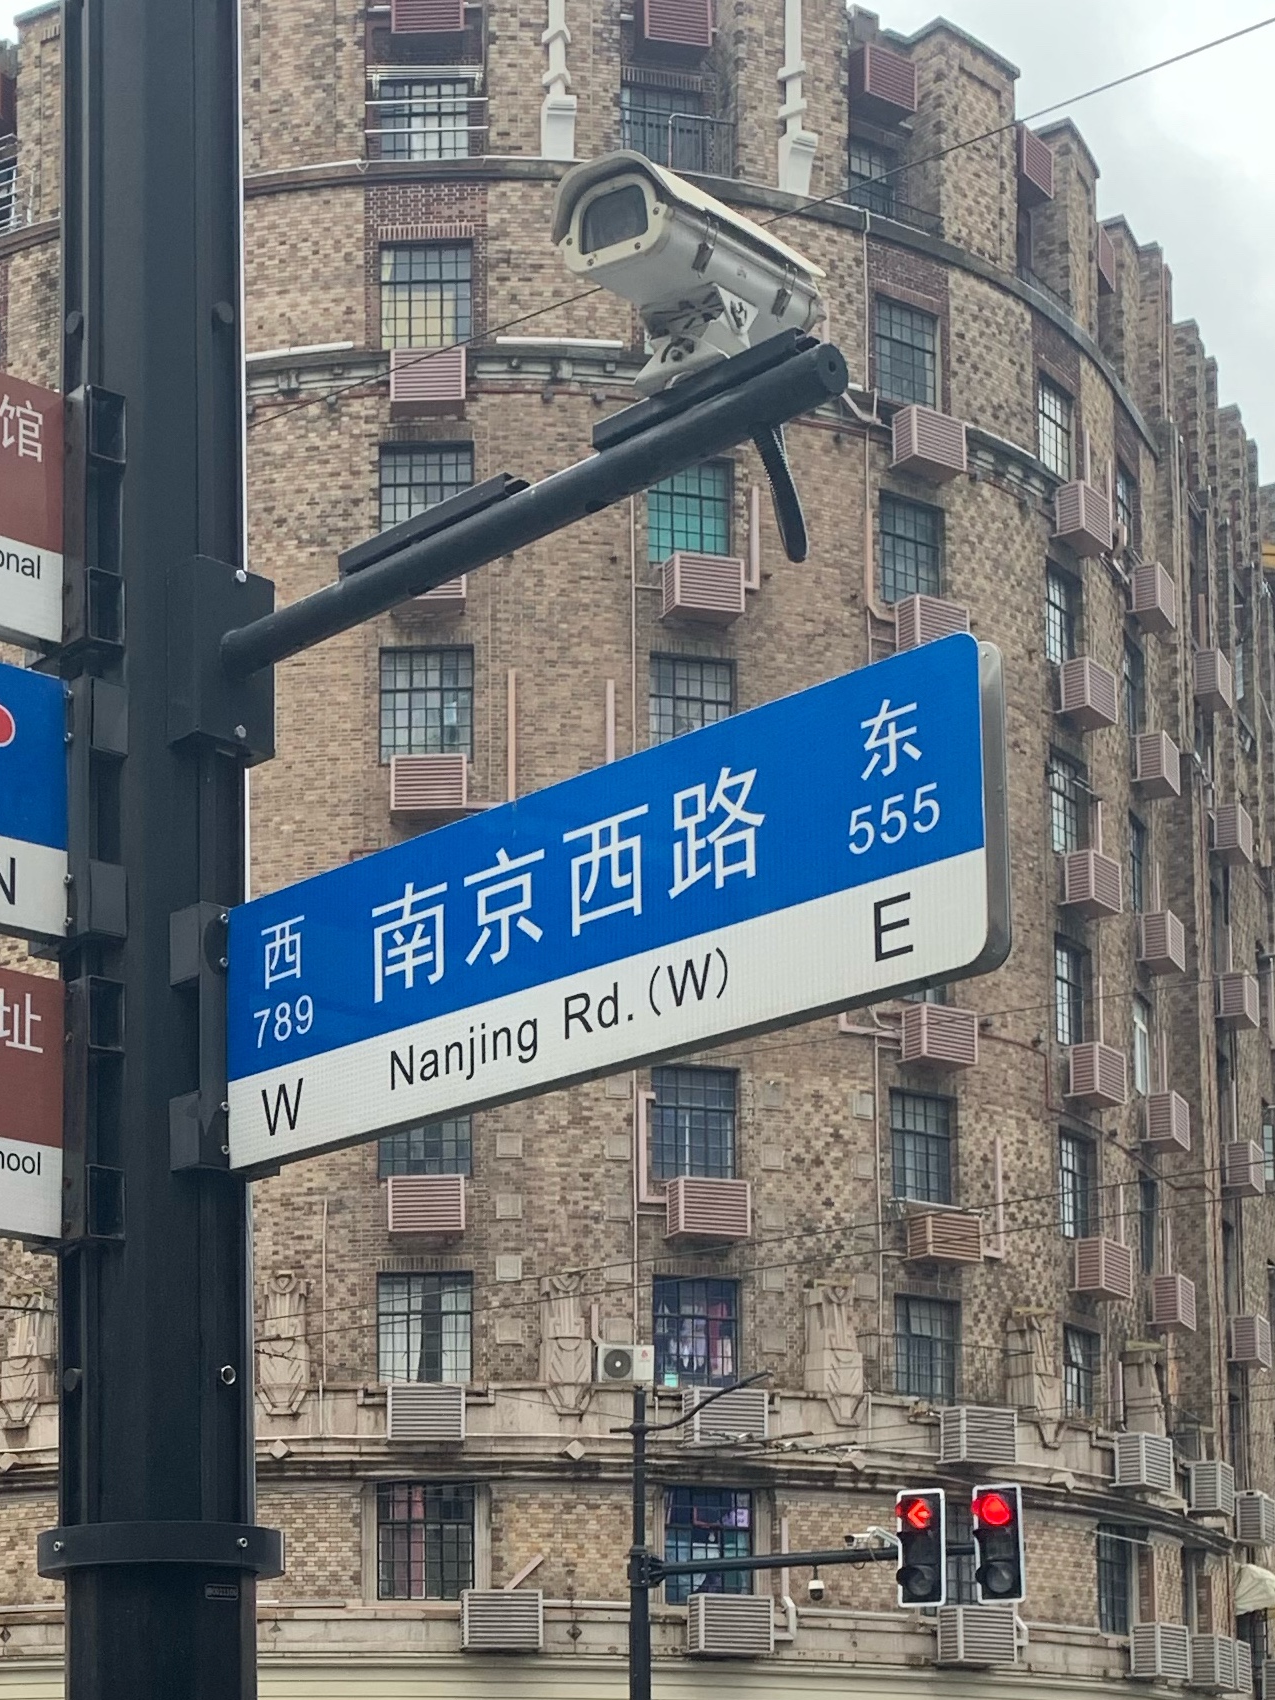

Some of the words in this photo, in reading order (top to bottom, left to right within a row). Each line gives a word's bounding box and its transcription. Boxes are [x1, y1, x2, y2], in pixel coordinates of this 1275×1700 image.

[861, 699, 922, 780] 东
[849, 783, 939, 854] 555
[371, 766, 765, 1003] 南京西路
[261, 915, 304, 989] 西
[873, 892, 914, 963] E
[254, 995, 313, 1048] 789
[391, 1018, 538, 1091] Nanjing
[565, 982, 634, 1040] Rd.
[650, 948, 728, 1017] (W)
[262, 1078, 304, 1137] W
